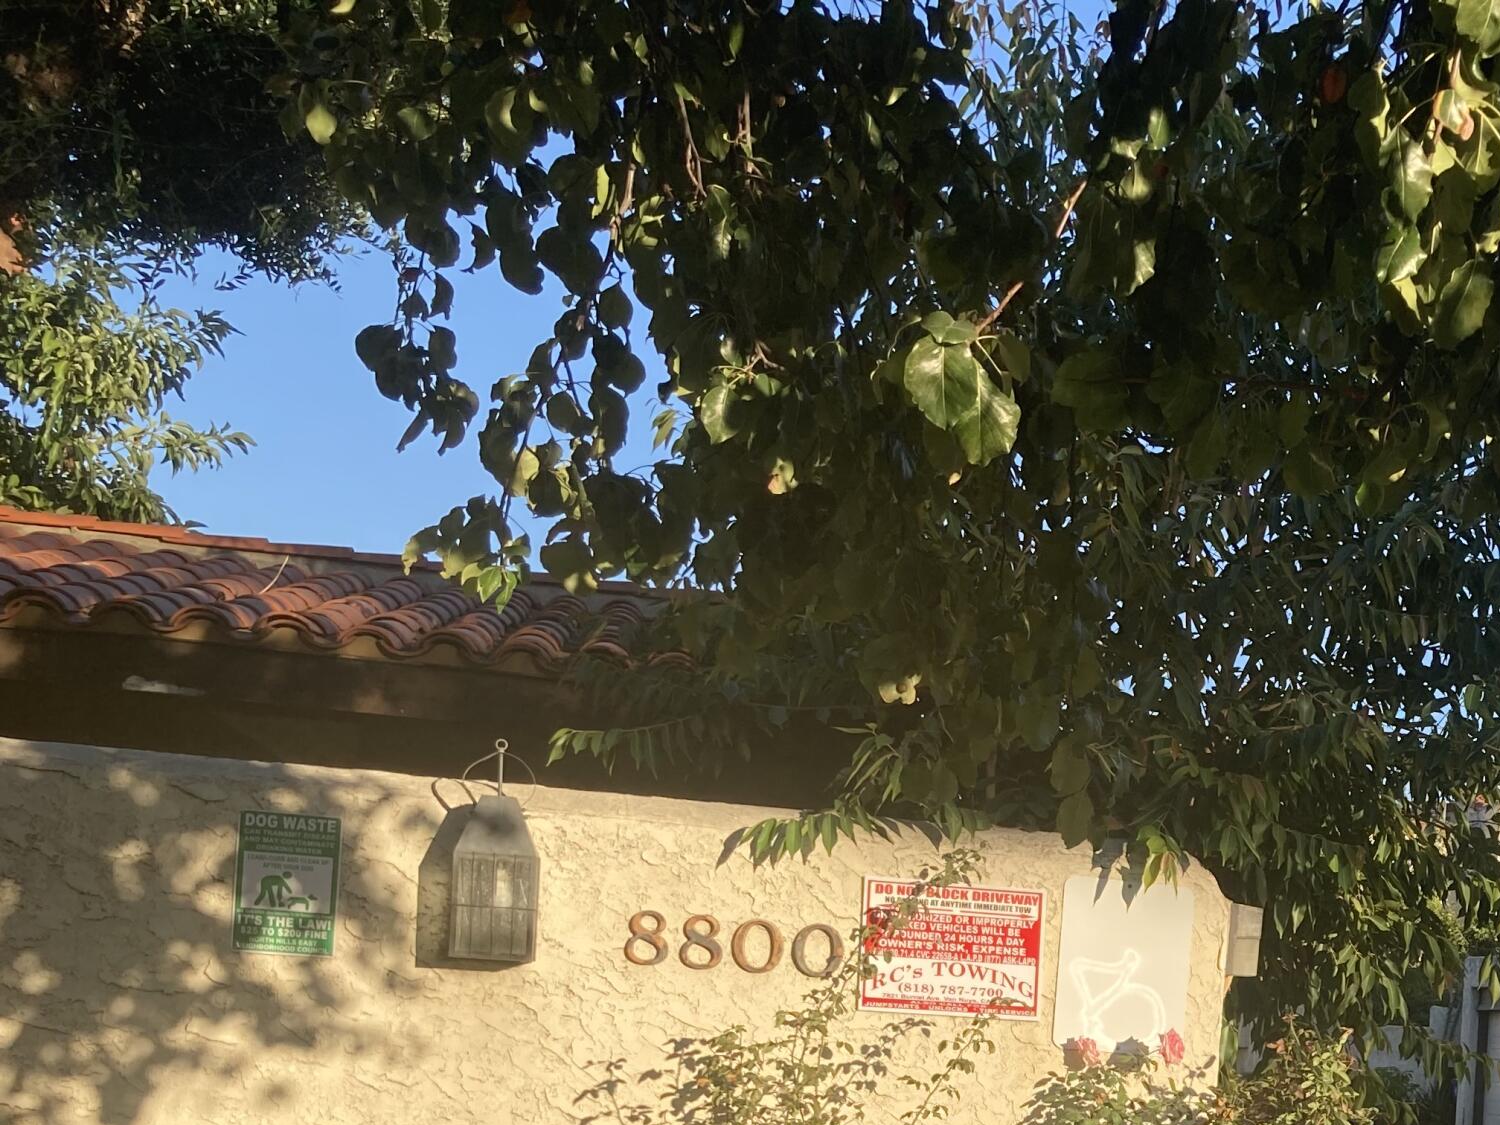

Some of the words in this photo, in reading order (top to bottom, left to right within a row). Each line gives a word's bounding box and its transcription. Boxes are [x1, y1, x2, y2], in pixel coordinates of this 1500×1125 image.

[245, 813, 279, 829] DOG
[283, 816, 338, 833] WASTE
[874, 883, 893, 895] DO
[896, 885, 923, 897] NO
[971, 891, 1039, 907] DRIVEWAY
[884, 895, 896, 904] NO
[940, 900, 972, 910] ANYTIME
[973, 902, 1013, 912] IMMEDIATE
[1014, 906, 1033, 914] TOW
[236, 913, 263, 926] IT'S
[266, 915, 294, 928] THE
[955, 915, 970, 925] OR
[971, 917, 1035, 930] IMPROPERLY
[261, 927, 275, 936] TO
[277, 928, 302, 938] $200
[304, 930, 328, 941] FINE
[929, 922, 979, 935] VEHICLES
[980, 926, 1005, 936] WILL
[1007, 928, 1021, 938] BE
[624, 910, 845, 978] 8800
[878, 938, 934, 950] OWNER'S
[936, 942, 970, 955] RISK,
[972, 945, 1027, 957] EXPENSE
[943, 933, 957, 943] 24
[958, 934, 994, 945] HOURS
[996, 937, 1004, 945] A
[1006, 937, 1025, 947] DAY
[915, 949, 931, 959] CVC
[1002, 955, 1037, 966] ASK-LAPD
[931, 961, 1034, 999] TOWING
[898, 982, 935, 995] (818)
[939, 985, 1003, 998] 787-7700
